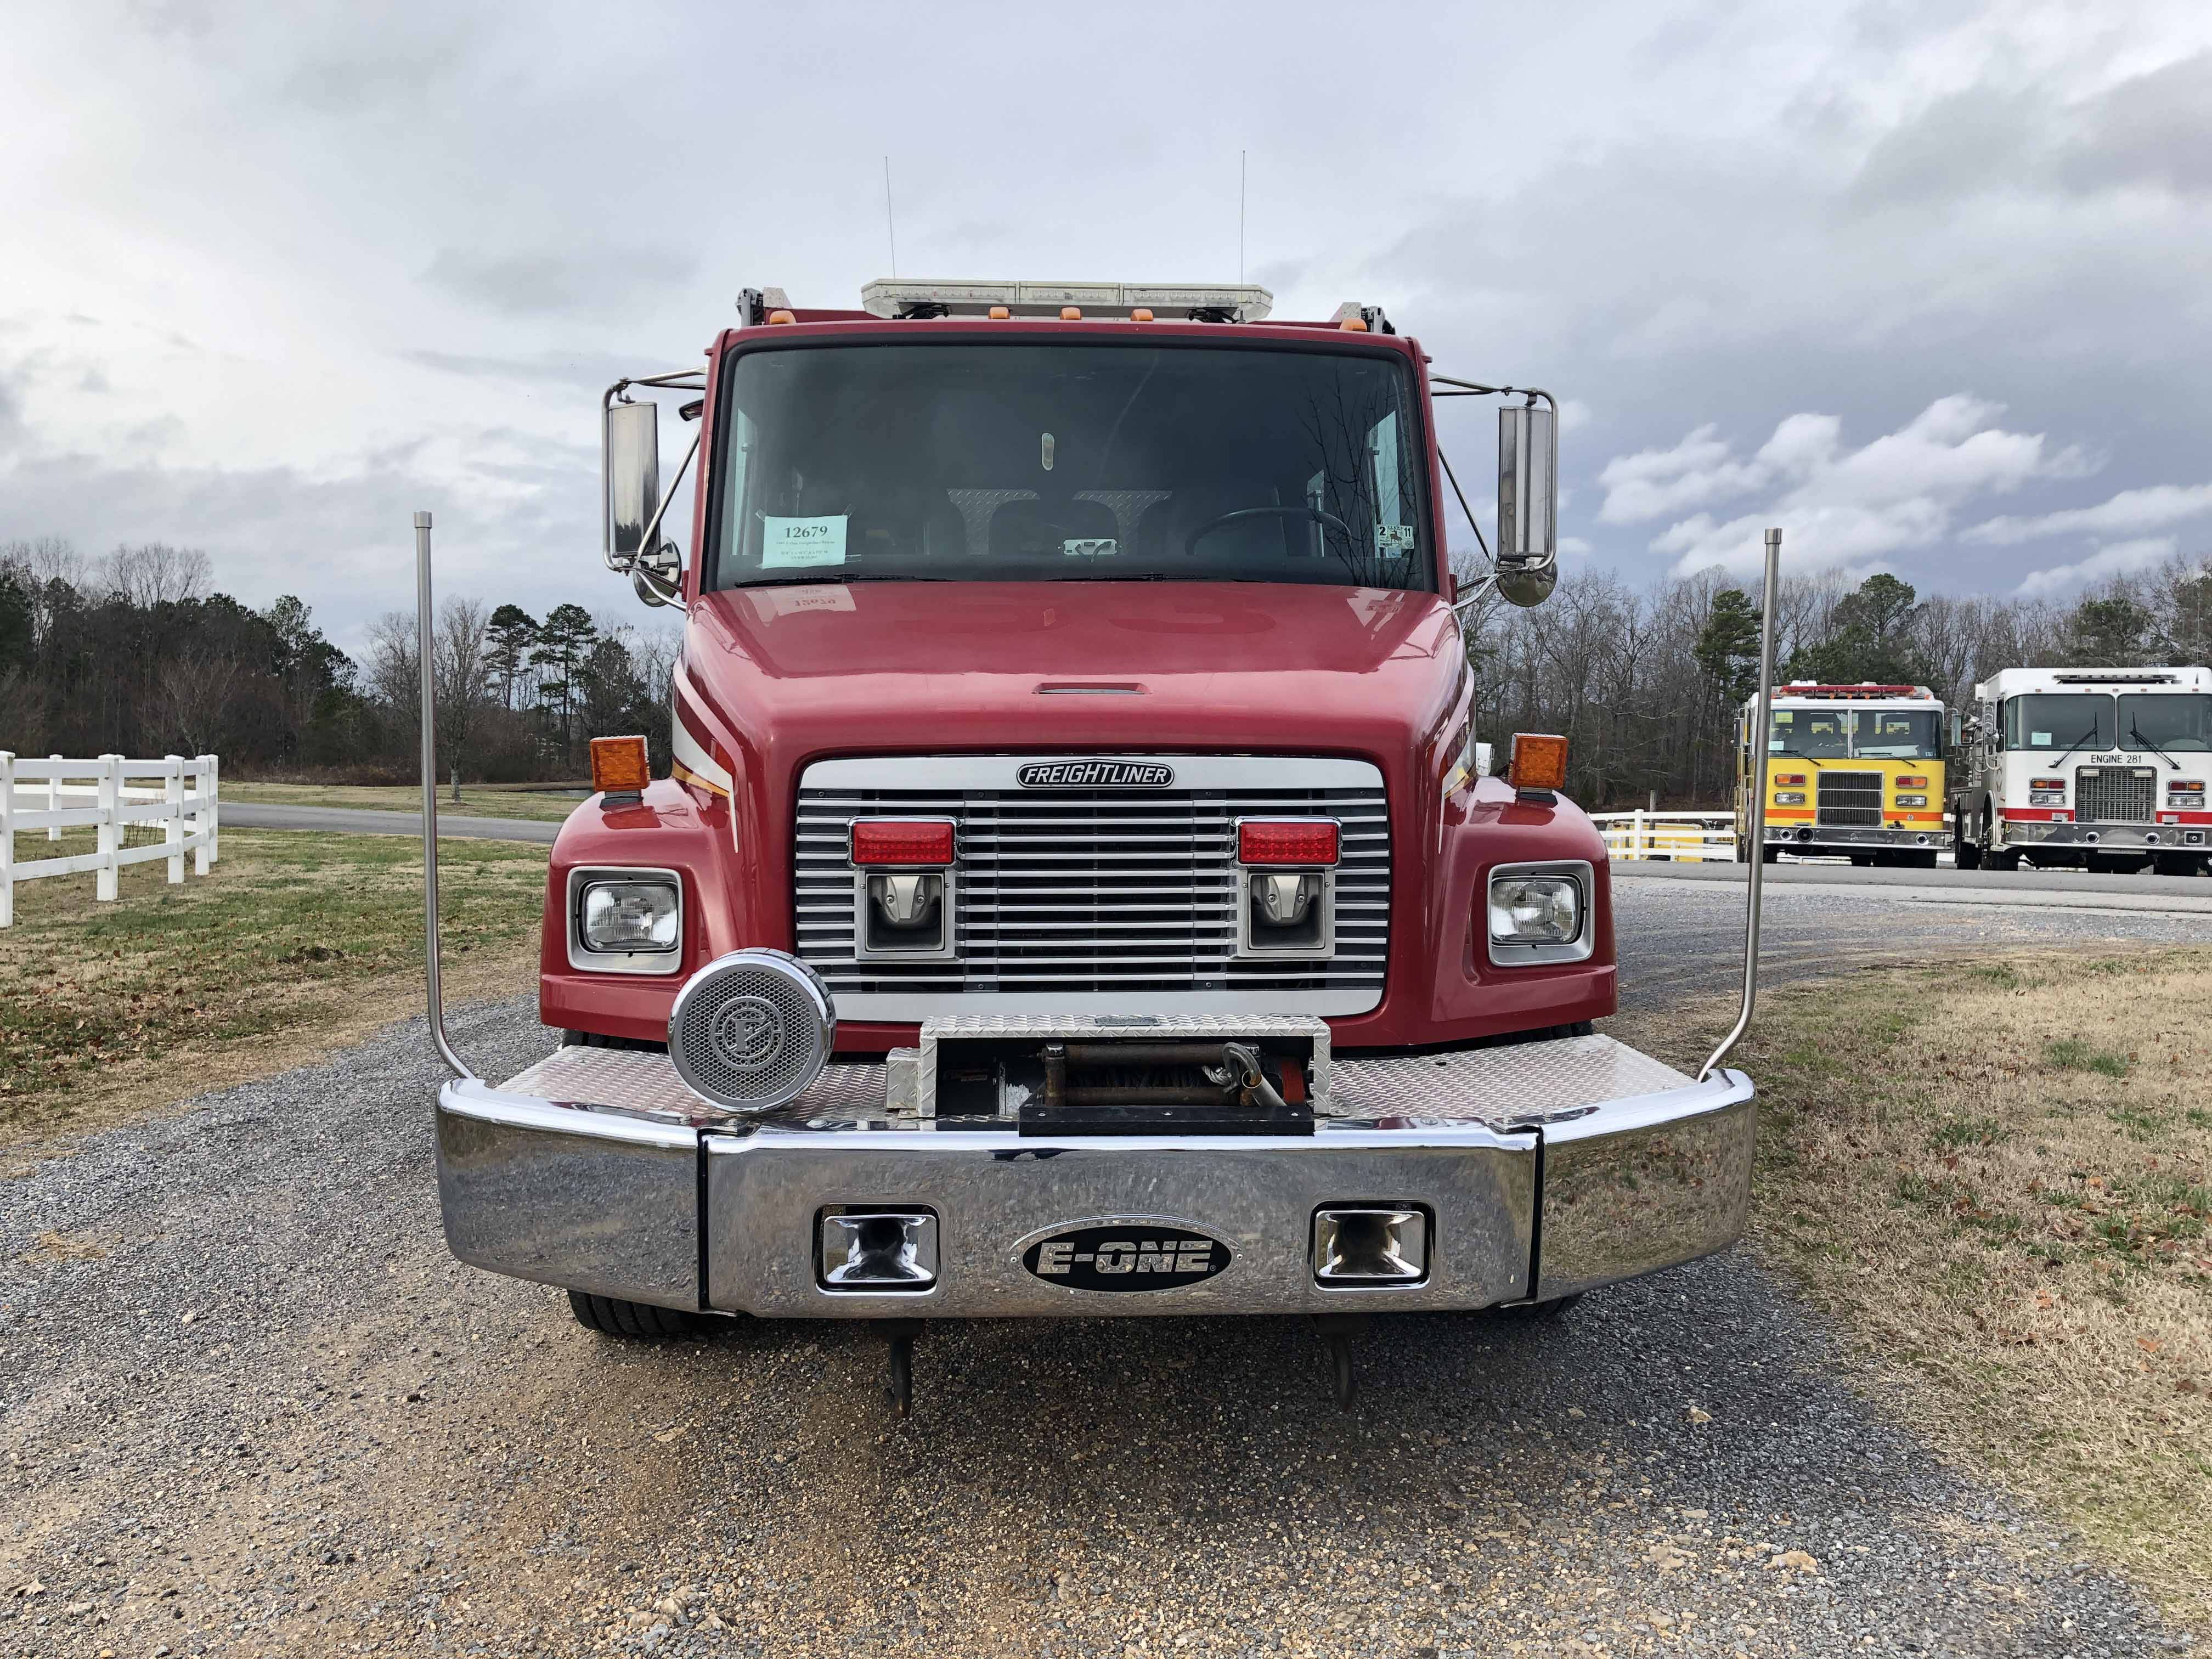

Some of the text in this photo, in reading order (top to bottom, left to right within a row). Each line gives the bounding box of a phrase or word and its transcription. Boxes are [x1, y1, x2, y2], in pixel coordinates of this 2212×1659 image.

[785, 526, 828, 538] 12679
[1379, 526, 1386, 536] 2
[1404, 527, 1411, 537] 11
[2091, 754, 2141, 764] ENGINE 281
[1024, 763, 1167, 783] FREIGHTLINER
[1036, 1240, 1213, 1274] E-ONE
